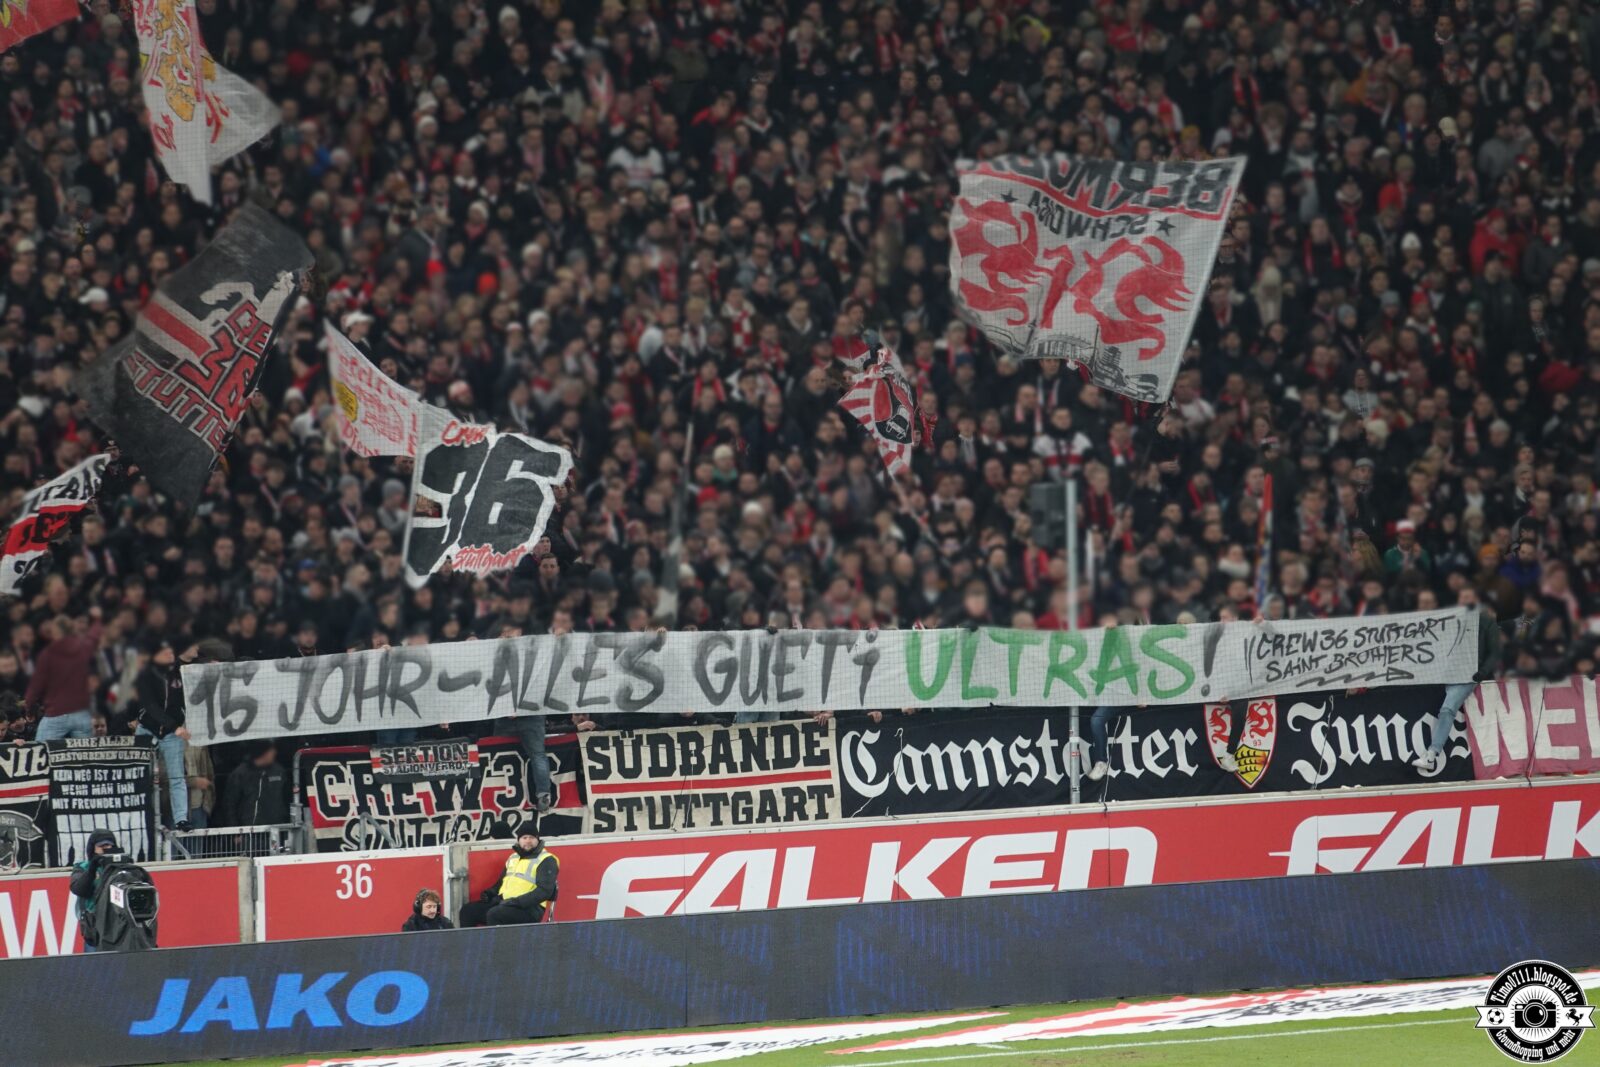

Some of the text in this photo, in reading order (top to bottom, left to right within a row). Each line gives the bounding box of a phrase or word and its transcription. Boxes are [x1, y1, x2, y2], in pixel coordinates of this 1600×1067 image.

[1353, 616, 1455, 649] STUTTGART
[1325, 641, 1435, 674] BROTHERS
[190, 662, 258, 740] 15
[65, 736, 135, 748] EHRE ALLEN
[118, 750, 151, 761] ULTRAS
[380, 742, 469, 764] SEKTION
[586, 720, 831, 781] SÜDBANDE
[53, 766, 145, 781] KEIN WEG IST ZU WEIT
[61, 784, 88, 795] WENN
[92, 783, 113, 795] MAN
[52, 798, 69, 810] MIT
[72, 797, 121, 809] FREUNDEN
[593, 784, 834, 833] STUTTGART
[336, 863, 373, 900] 36
[577, 827, 1158, 920] FALKEN
[129, 970, 429, 1036] JAKO
